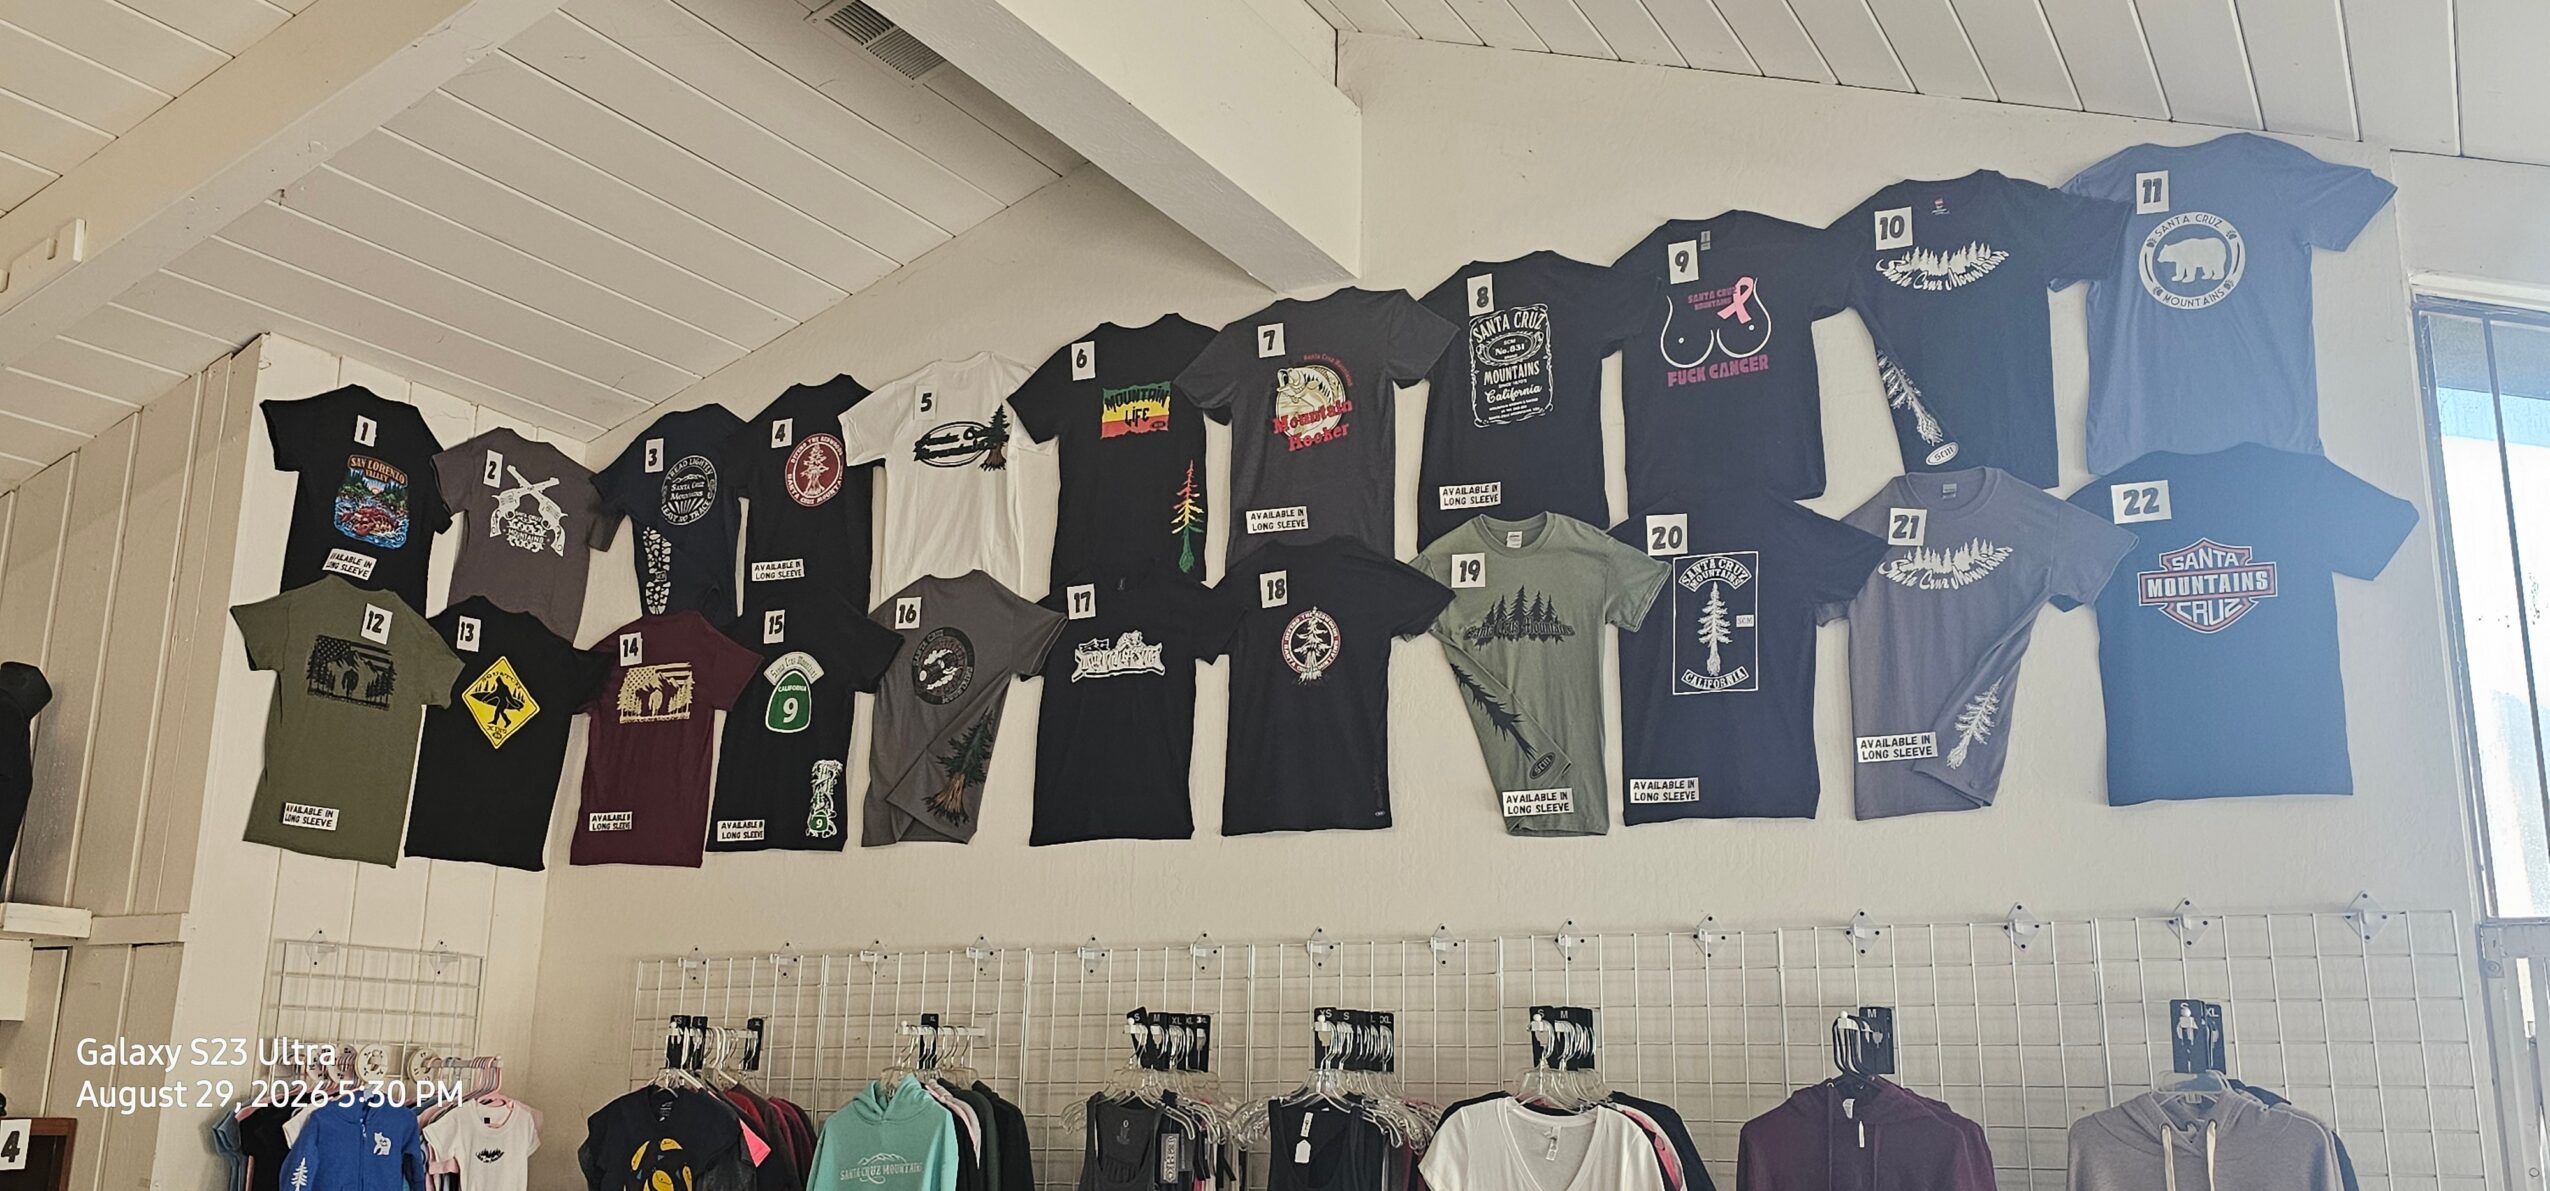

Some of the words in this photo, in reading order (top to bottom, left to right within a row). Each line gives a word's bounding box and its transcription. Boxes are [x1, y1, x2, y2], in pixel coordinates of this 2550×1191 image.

[2142, 178, 2162, 204] 11
[1879, 215, 1905, 241] 10
[2154, 215, 2190, 237] SANTA
[2195, 214, 2223, 228] CRUZ
[1675, 250, 1690, 273] 9
[1476, 286, 1489, 308] 8
[1688, 290, 1715, 304] SANTA
[2163, 289, 2225, 307] MOUNTAINS
[1473, 314, 1510, 343] SANTA
[1514, 311, 1546, 330] CRUZ
[1263, 330, 1275, 351] 7
[1076, 348, 1088, 368] 6
[1484, 360, 1540, 386] MOUNTAINS
[1667, 366, 1707, 388] FUCK
[1709, 354, 1769, 379] CANCER
[920, 393, 932, 412] 5
[1484, 384, 1543, 403] California
[1273, 400, 1353, 434] Mountain
[360, 421, 369, 441] 1
[775, 423, 786, 442] 4
[1288, 423, 1349, 452] Hooker
[648, 448, 658, 467] 3
[350, 457, 366, 469] SAN
[367, 460, 406, 484] LORENZO
[365, 470, 389, 482] VALLEY
[487, 460, 497, 479] 2
[1443, 485, 1490, 496] AVAILABLE
[1444, 497, 1467, 506] LONG
[1470, 494, 1498, 504] SLEEVE
[2123, 487, 2160, 516] 22
[1251, 509, 1295, 520] AVAILABLE
[1252, 522, 1274, 531] LONG
[1277, 519, 1306, 529] SLEEVE
[1892, 514, 1920, 539] 21
[1651, 525, 1683, 550] 20
[364, 560, 372, 569] IN
[755, 561, 795, 571] AVAILABLE
[2171, 547, 2239, 571] SANTA
[340, 563, 370, 577] SLEEVE
[756, 570, 776, 580] LONG
[778, 569, 802, 578] SLEEVE
[1459, 560, 1481, 583] 19
[1682, 559, 1716, 586] SANTA
[1719, 559, 1749, 581] CRUZ
[1689, 568, 1742, 590] MOUNTAINS
[1267, 578, 1285, 600] 18
[2147, 571, 2269, 598] MOUNTAINS
[1074, 591, 1091, 613] 17
[2176, 598, 2243, 626] CRUZ
[366, 610, 385, 634] 12
[898, 604, 917, 624] 16
[460, 621, 474, 641] 13
[768, 614, 783, 635] 15
[623, 637, 638, 657] 14
[1684, 667, 1746, 689] CALIFORNIA
[783, 697, 799, 723] 9
[1861, 736, 1918, 749] AVAILABLE
[1921, 735, 1931, 744] IN
[1862, 749, 1889, 760] LONG
[1893, 746, 1933, 758] SLEEVE
[1633, 780, 1685, 790] AVAILABLE
[1687, 780, 1695, 788] IN
[1506, 792, 1557, 804] AVAILABLE
[1560, 792, 1568, 800] IN
[1634, 792, 1659, 801] LONG
[1663, 790, 1696, 801] SLEEVE
[286, 804, 323, 816] AVAILABLE
[1508, 805, 1531, 815] LONG
[1536, 803, 1569, 813] SLEEVE
[285, 813, 300, 823] LONG
[302, 816, 333, 827] SLEEVE
[816, 819, 823, 829] 9
[722, 831, 741, 839] LONG
[1134, 1013, 1141, 1022] S
[1153, 1014, 1160, 1022] M
[1343, 1012, 1350, 1020] S
[1560, 1010, 1568, 1019] M
[1867, 1009, 1877, 1018] M
[0, 1130, 21, 1163] 4
